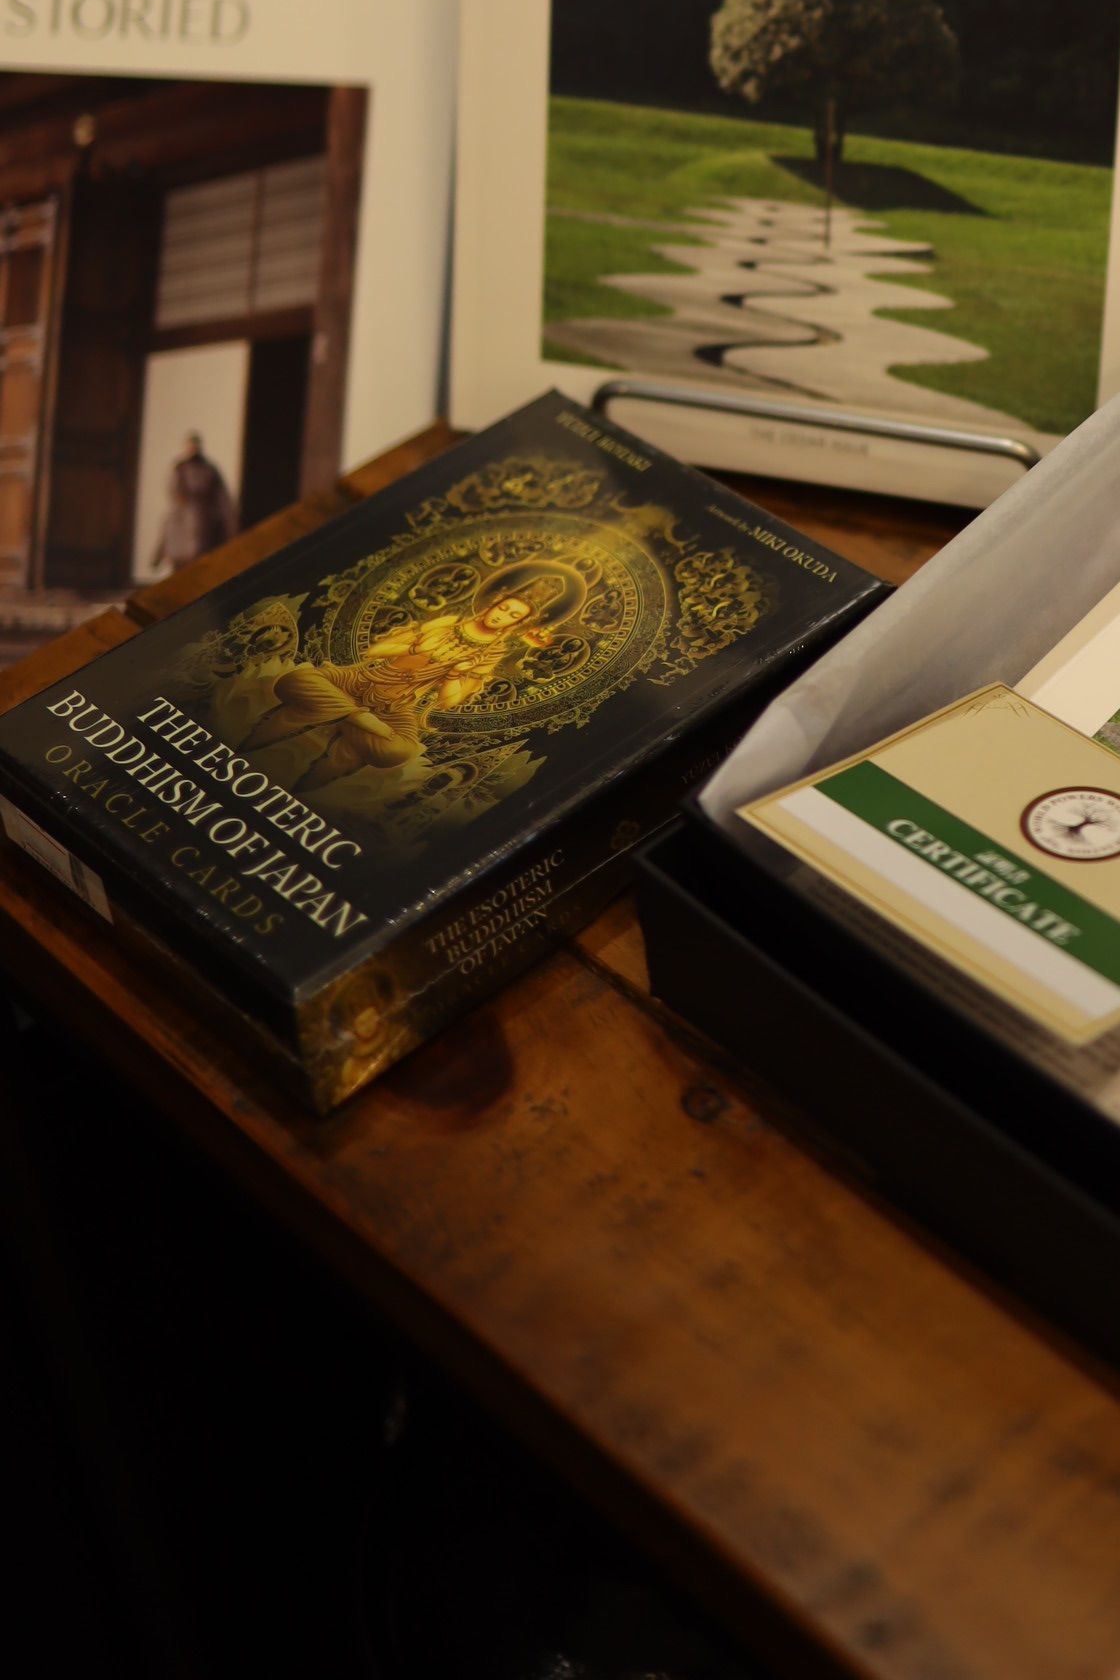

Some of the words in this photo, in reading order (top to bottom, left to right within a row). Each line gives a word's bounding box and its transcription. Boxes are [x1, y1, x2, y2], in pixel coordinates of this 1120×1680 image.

[748, 525, 789, 554] MIKI
[782, 546, 840, 584] OKUDA
[45, 744, 171, 845] ORACLE
[171, 846, 284, 935] CARDS
[47, 689, 223, 826] BUDDHISM
[209, 817, 270, 859] OF
[242, 851, 367, 938] JAPAN
[137, 696, 213, 755] THE
[192, 742, 363, 868] ESOTERIC
[424, 917, 468, 954] THE
[469, 848, 566, 925] ESOTERIC
[448, 879, 553, 963] BUDDHISM
[886, 819, 1082, 945] CERTIFICATE
